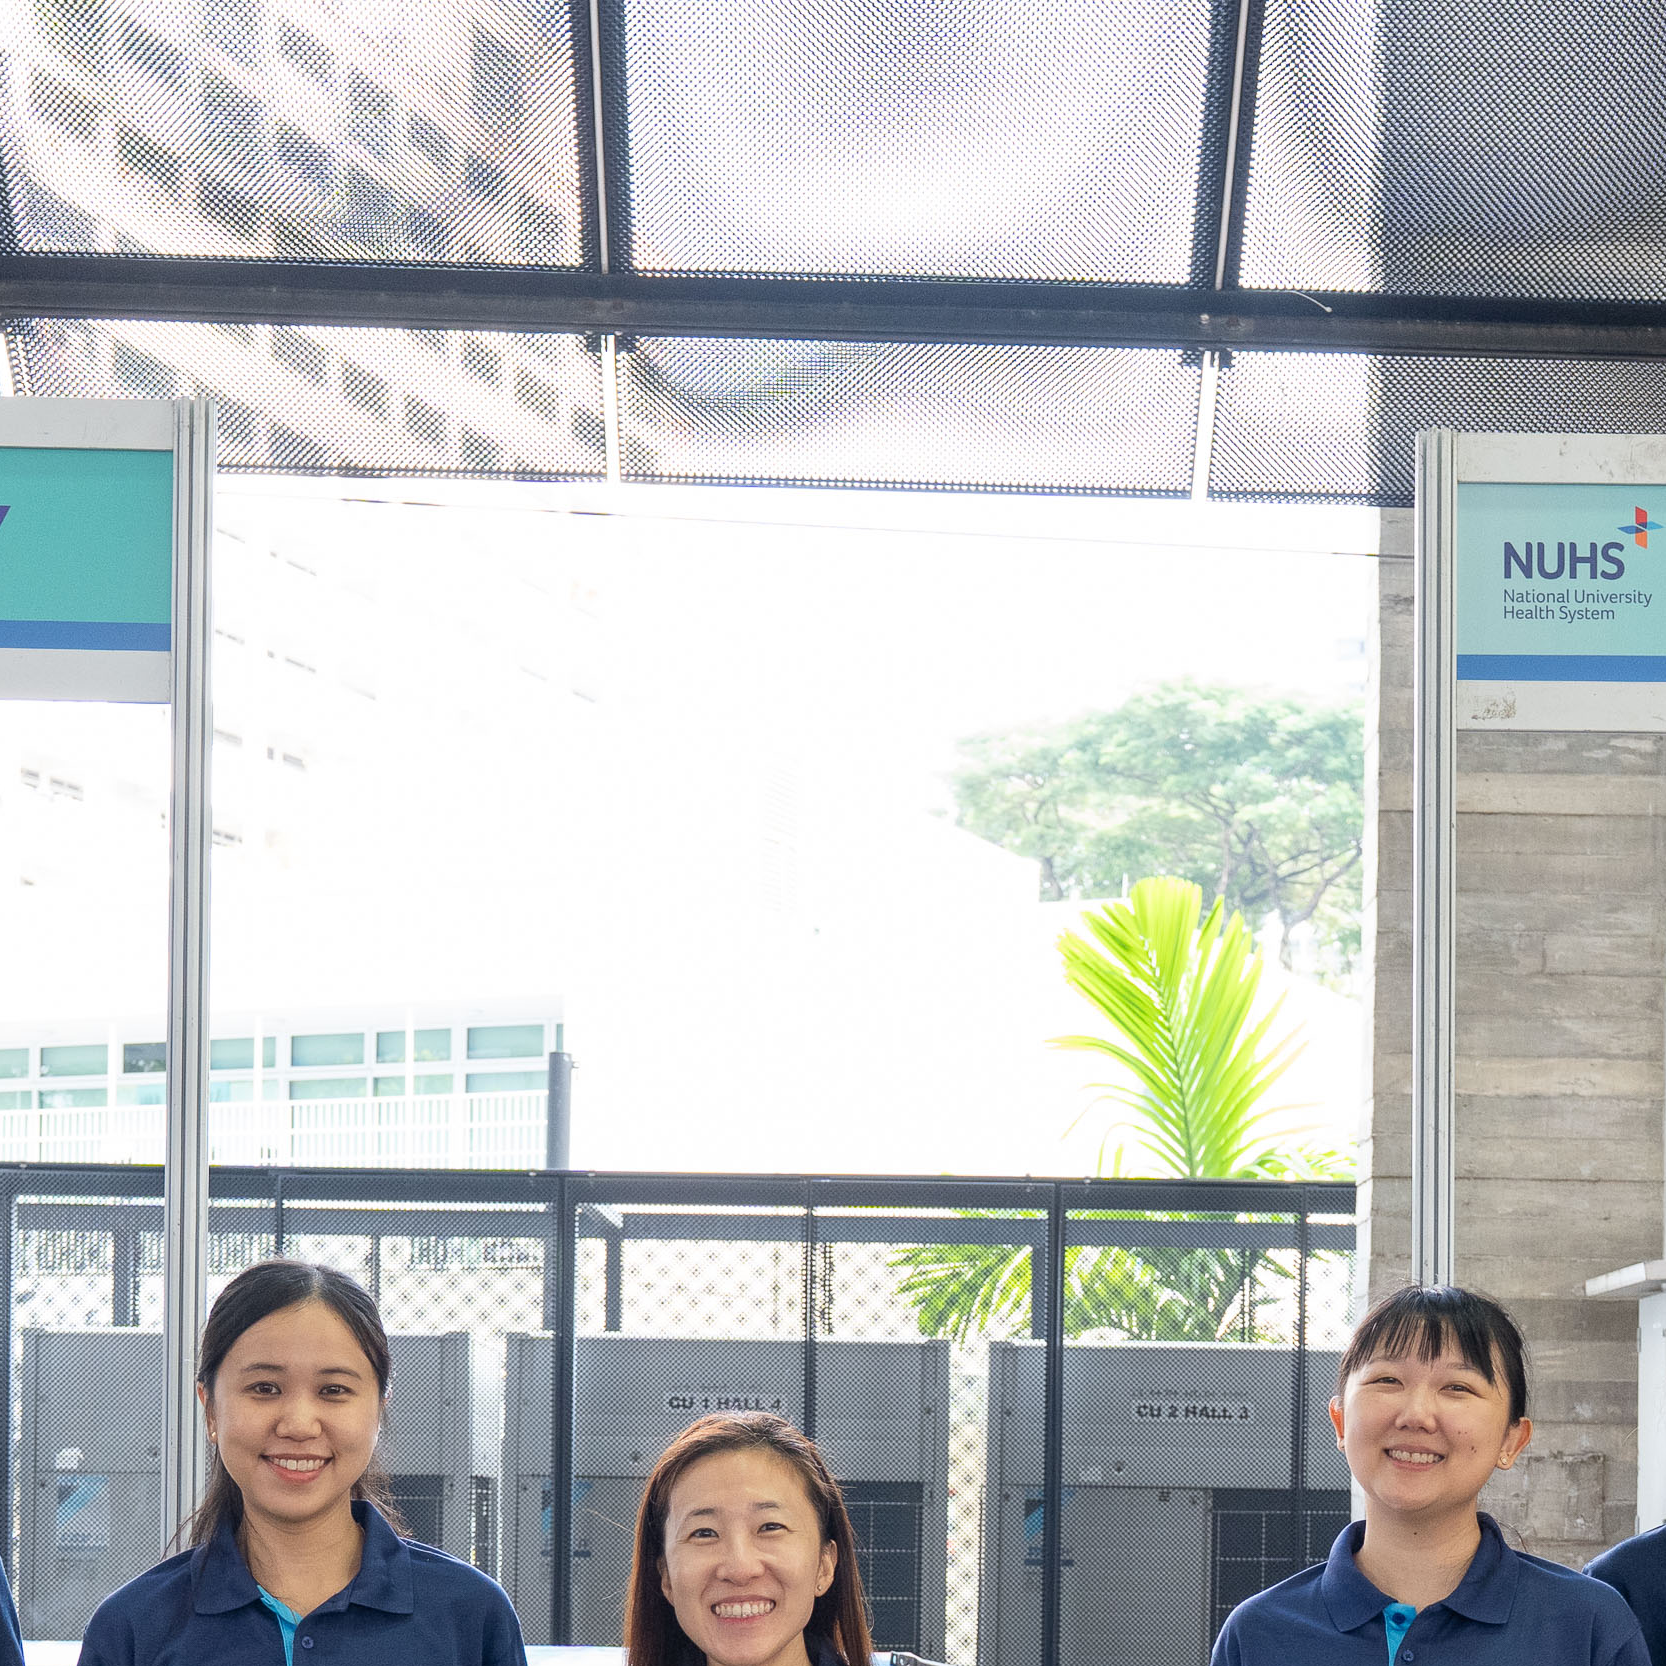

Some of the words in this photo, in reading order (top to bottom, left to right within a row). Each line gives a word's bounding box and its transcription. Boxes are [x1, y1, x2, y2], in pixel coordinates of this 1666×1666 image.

[1503, 541, 1625, 580] NUHS
[1503, 588, 1570, 604] National
[1574, 589, 1653, 608] University
[1503, 605, 1555, 620] Health
[1558, 605, 1615, 624] System
[1135, 1404, 1162, 1419] CU
